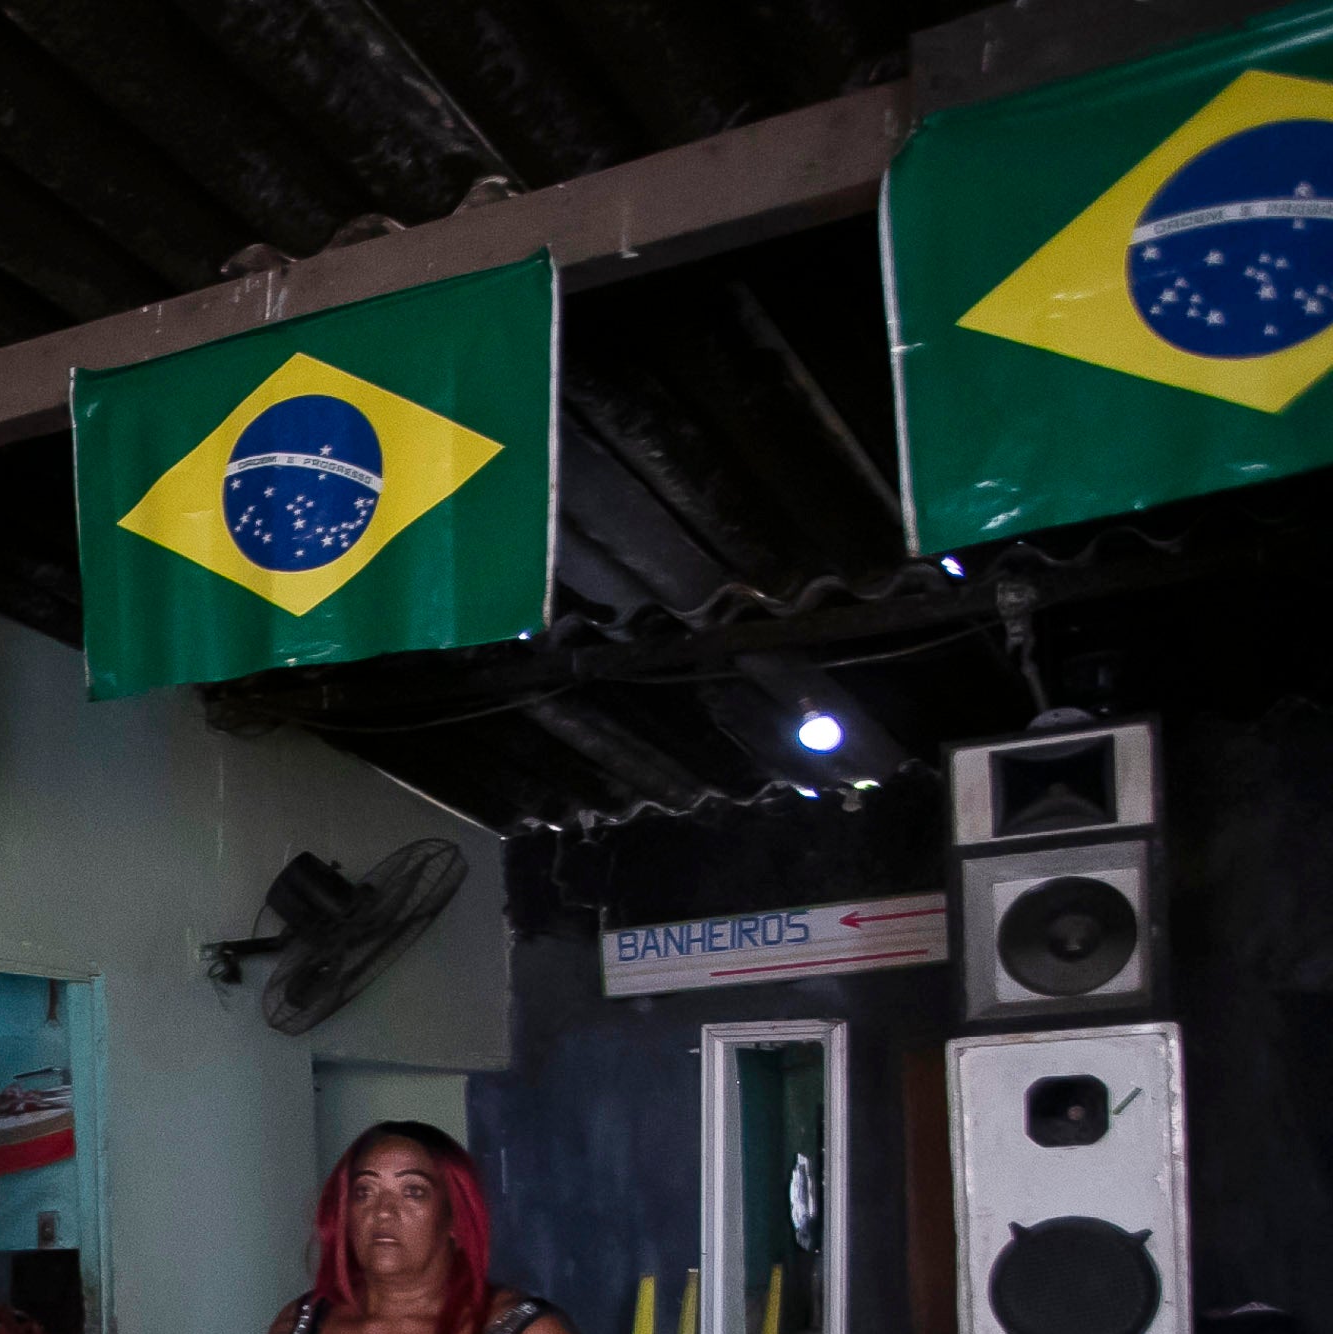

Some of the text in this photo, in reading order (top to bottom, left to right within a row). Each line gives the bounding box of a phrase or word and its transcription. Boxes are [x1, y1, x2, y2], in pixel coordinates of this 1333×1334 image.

[237, 455, 277, 470] ORDEM
[302, 458, 374, 485] PROGRESSO
[617, 910, 810, 963] BANHEIROS
